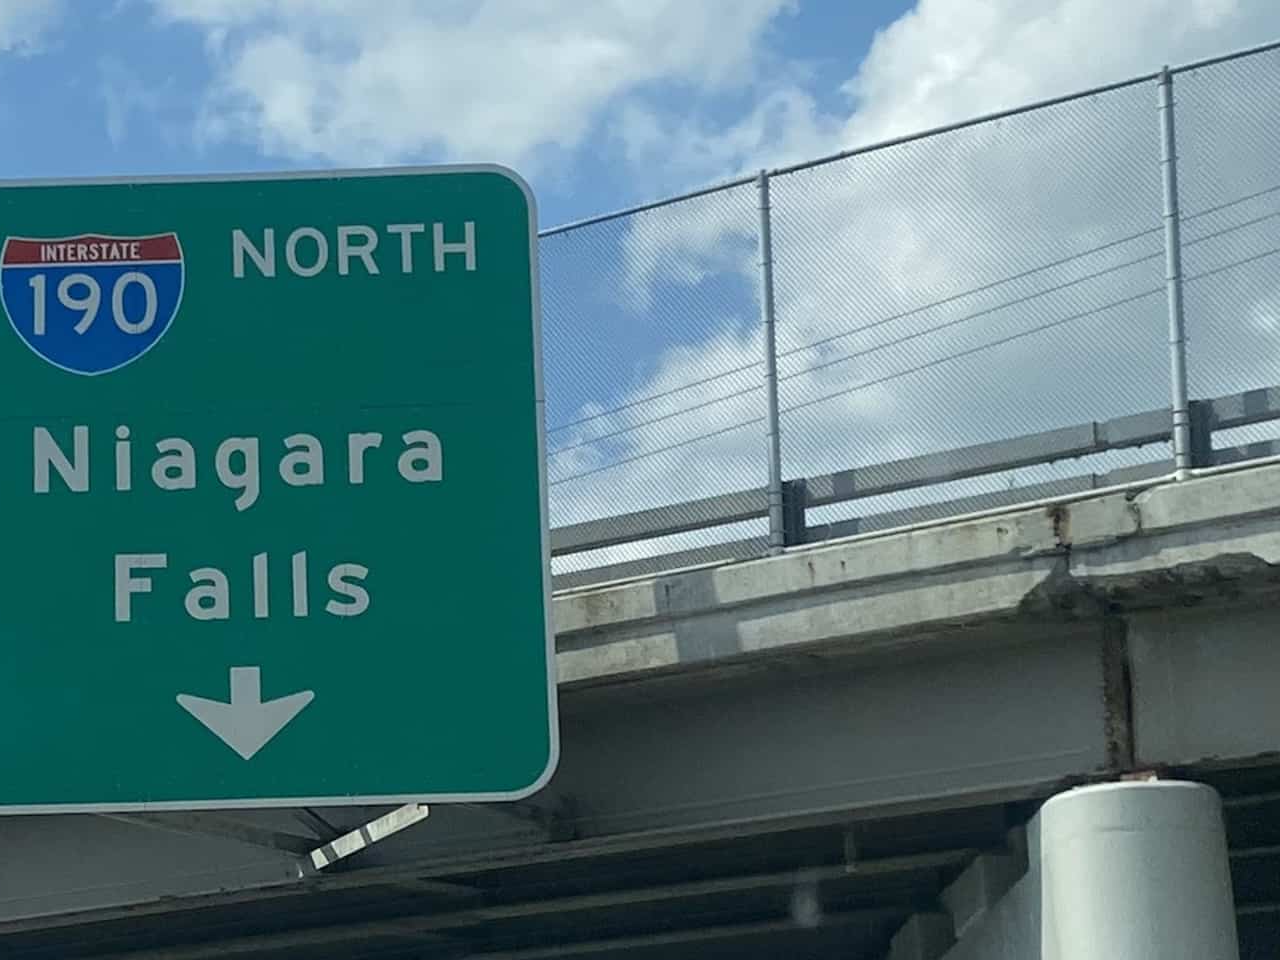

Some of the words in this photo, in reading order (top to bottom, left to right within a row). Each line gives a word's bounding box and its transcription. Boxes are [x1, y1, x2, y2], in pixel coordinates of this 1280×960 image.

[40, 242, 141, 262] INTERSTATE
[232, 221, 477, 278] NORTH
[28, 271, 158, 336] 190
[33, 425, 443, 512] Niagara
[114, 551, 371, 623] Falls
